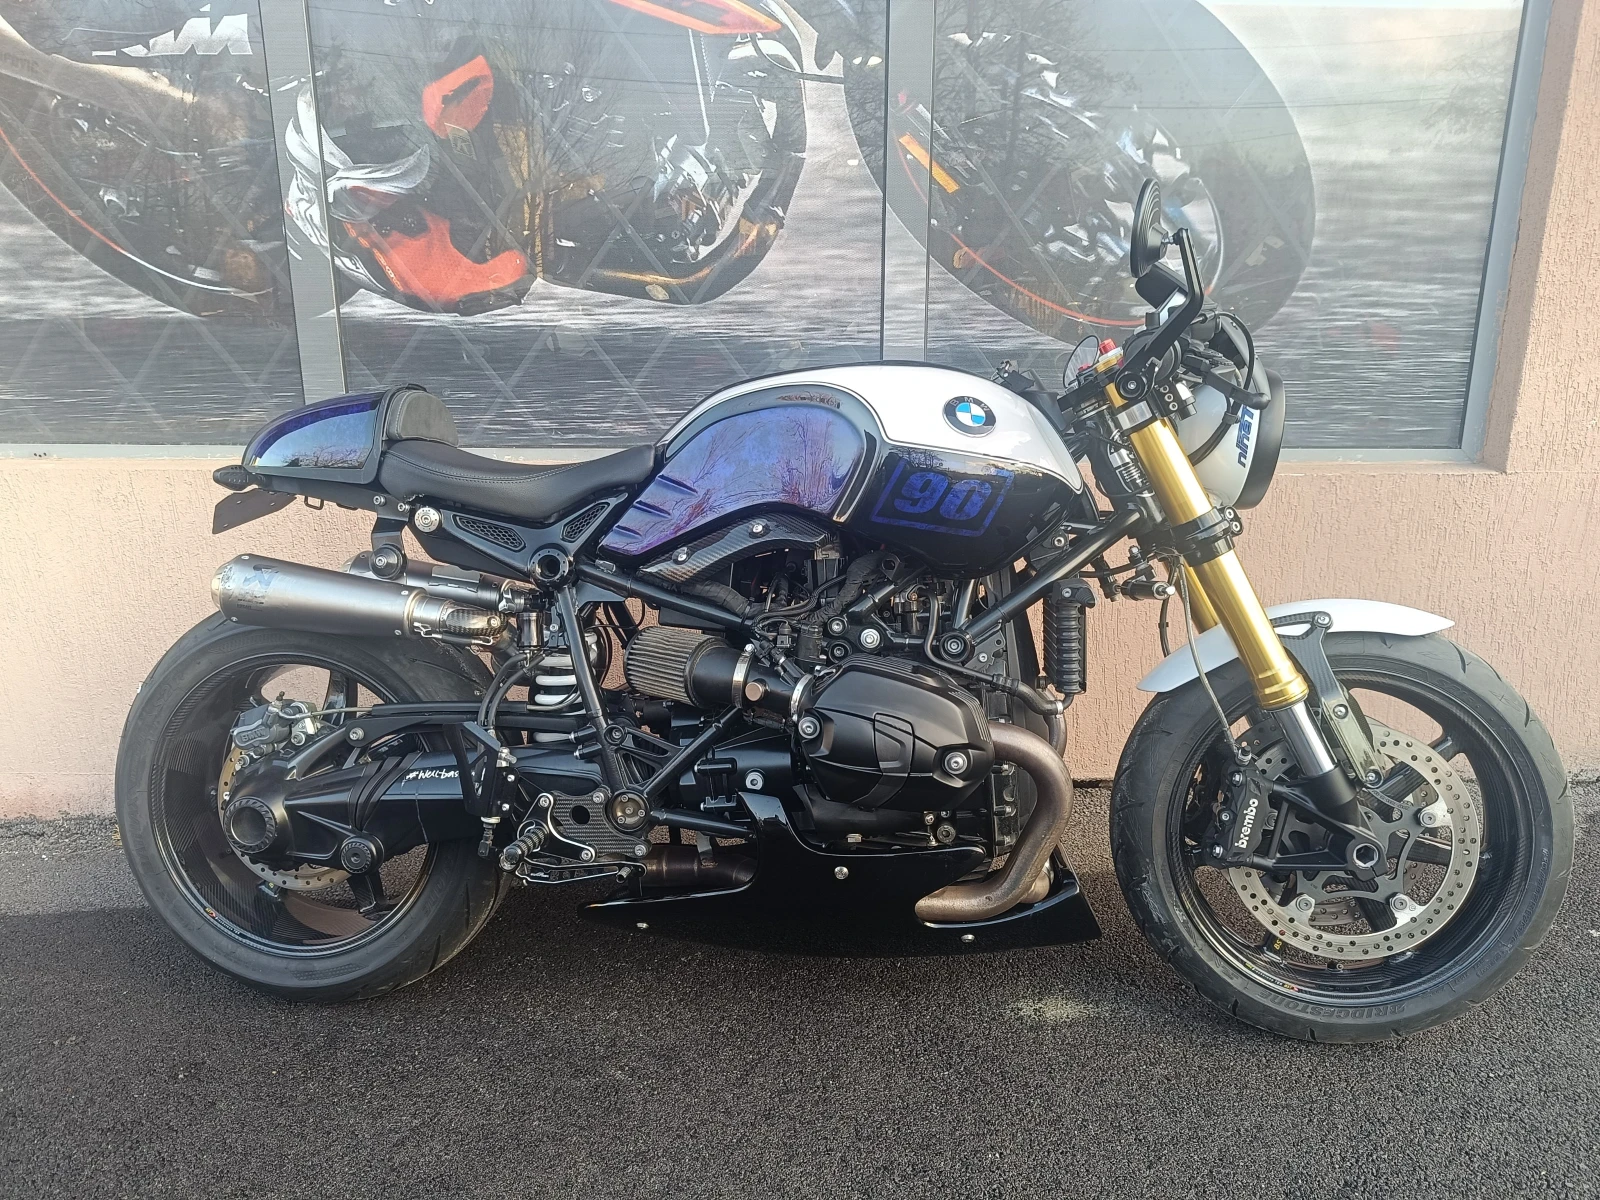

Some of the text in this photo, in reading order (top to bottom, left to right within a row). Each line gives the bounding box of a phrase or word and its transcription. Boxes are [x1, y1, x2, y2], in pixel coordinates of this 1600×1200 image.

[894, 471, 992, 521] 90
[241, 726, 266, 742] BMW
[1234, 798, 1259, 849] brembo
[1256, 988, 1406, 1020] BRIDGESTONE
